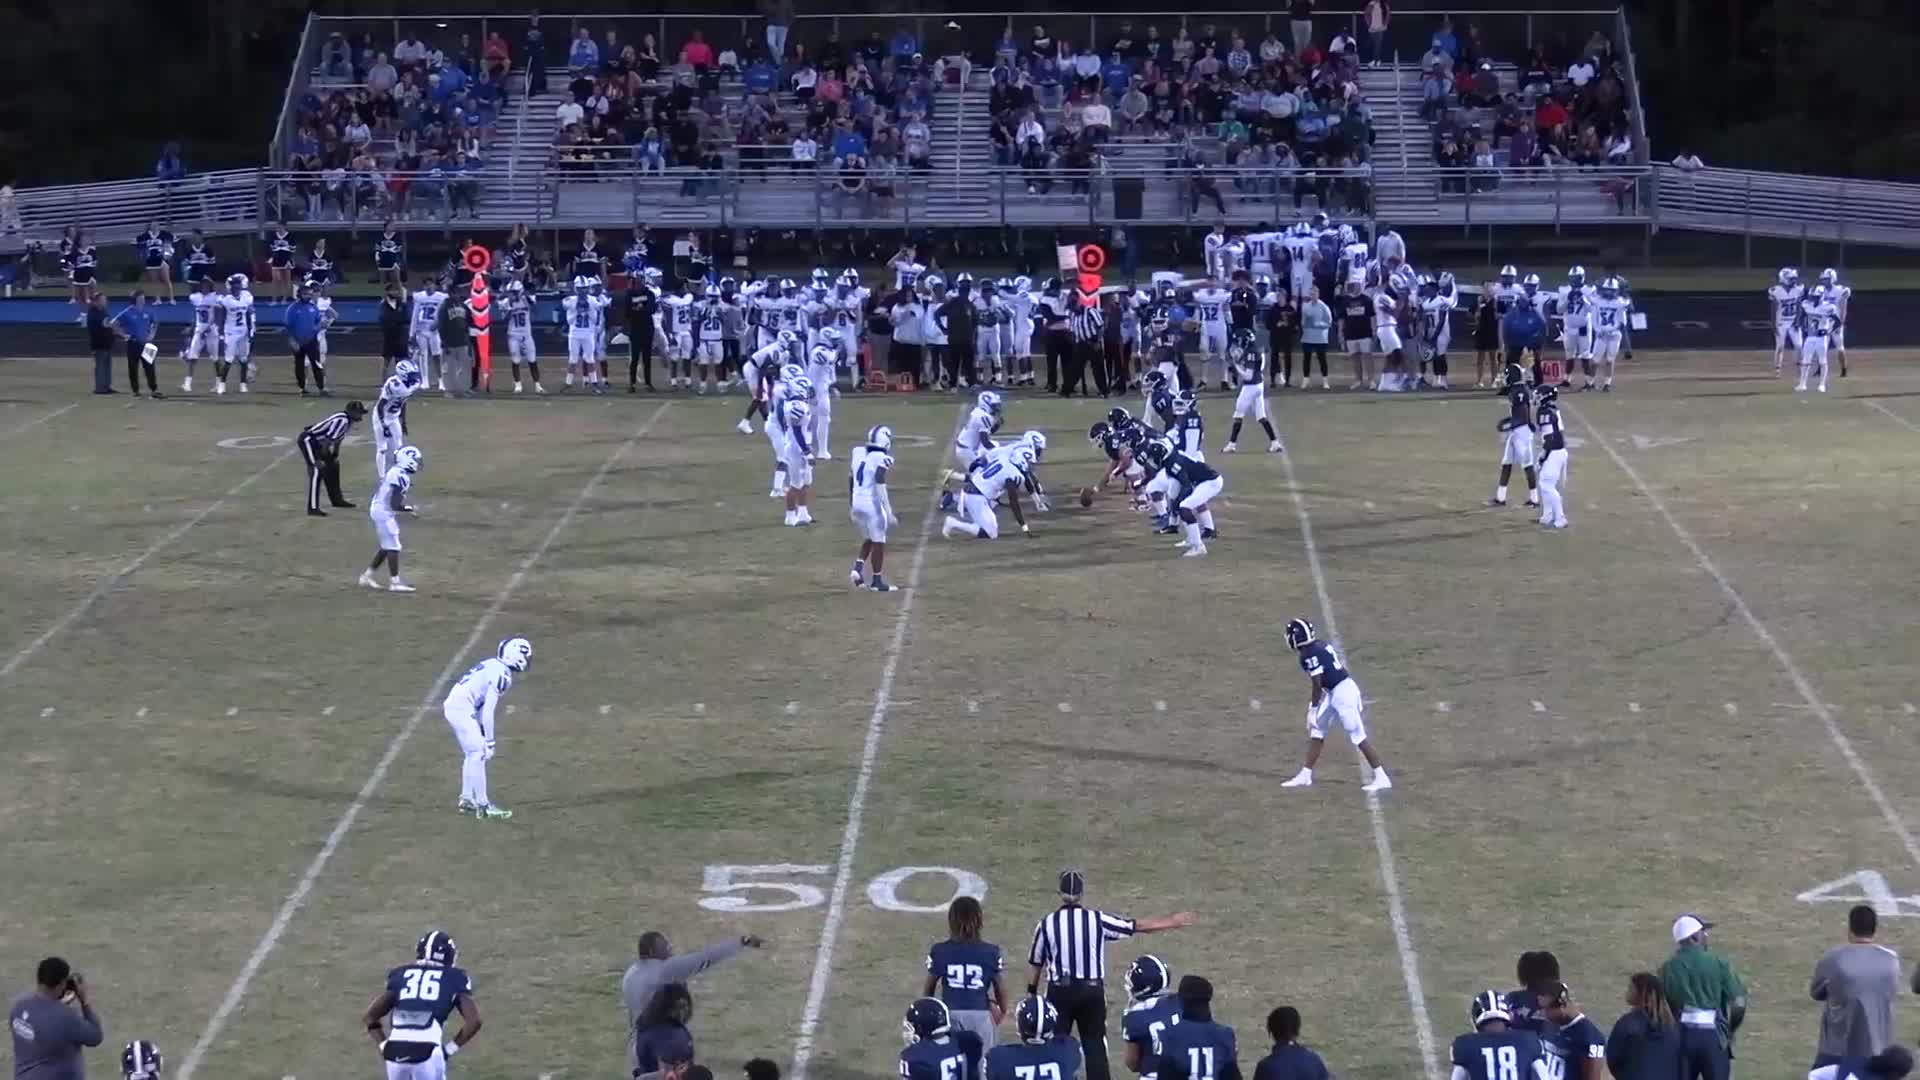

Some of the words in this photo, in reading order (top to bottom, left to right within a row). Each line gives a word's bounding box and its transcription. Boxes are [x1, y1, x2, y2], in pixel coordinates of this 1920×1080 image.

[400, 969, 443, 1000] 36
[1188, 1047, 1214, 1080] 11
[1482, 1046, 1519, 1080] 18
